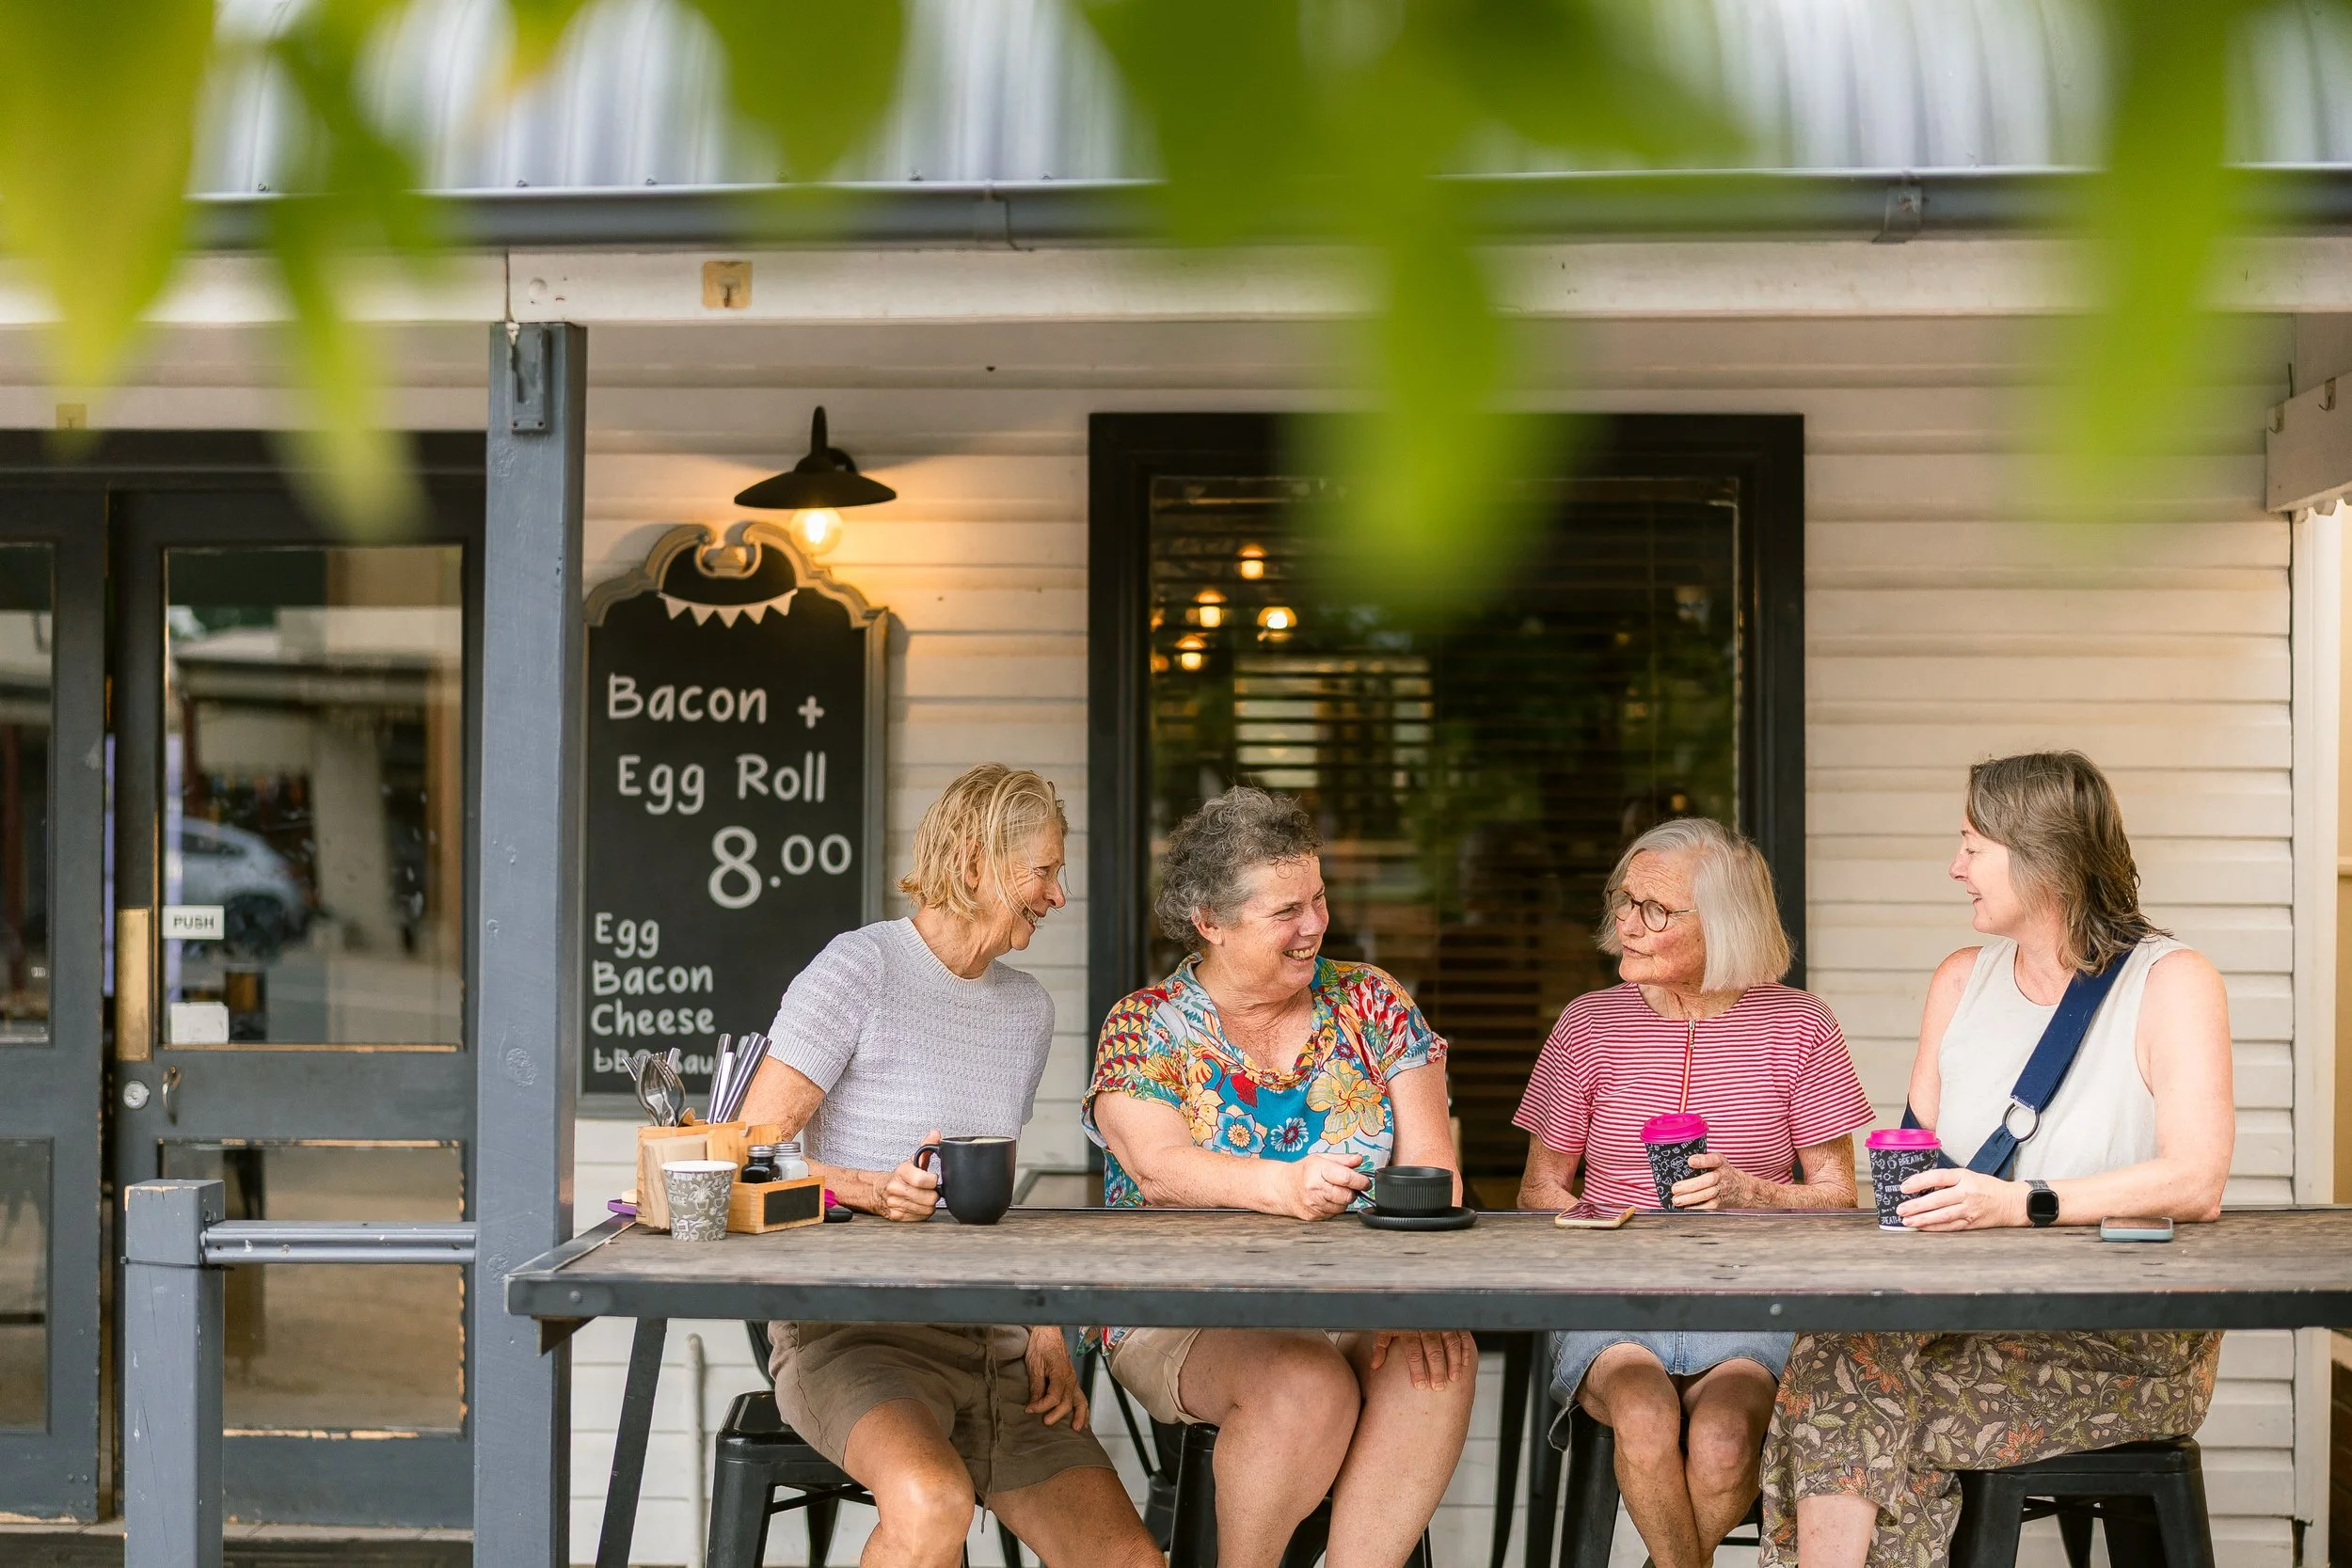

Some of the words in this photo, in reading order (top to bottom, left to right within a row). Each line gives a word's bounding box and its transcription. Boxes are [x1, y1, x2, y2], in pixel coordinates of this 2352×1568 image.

[608, 673, 767, 723] Bacon
[798, 696, 825, 729] +
[618, 754, 705, 816] Egg
[737, 752, 826, 802] Roll
[707, 826, 852, 910] 8.00
[173, 914, 215, 929] PUSH
[594, 911, 660, 959] Egg
[593, 959, 713, 996] Bacon
[591, 999, 716, 1038] Cheese
[1898, 1153, 1925, 1166] BREATHE
